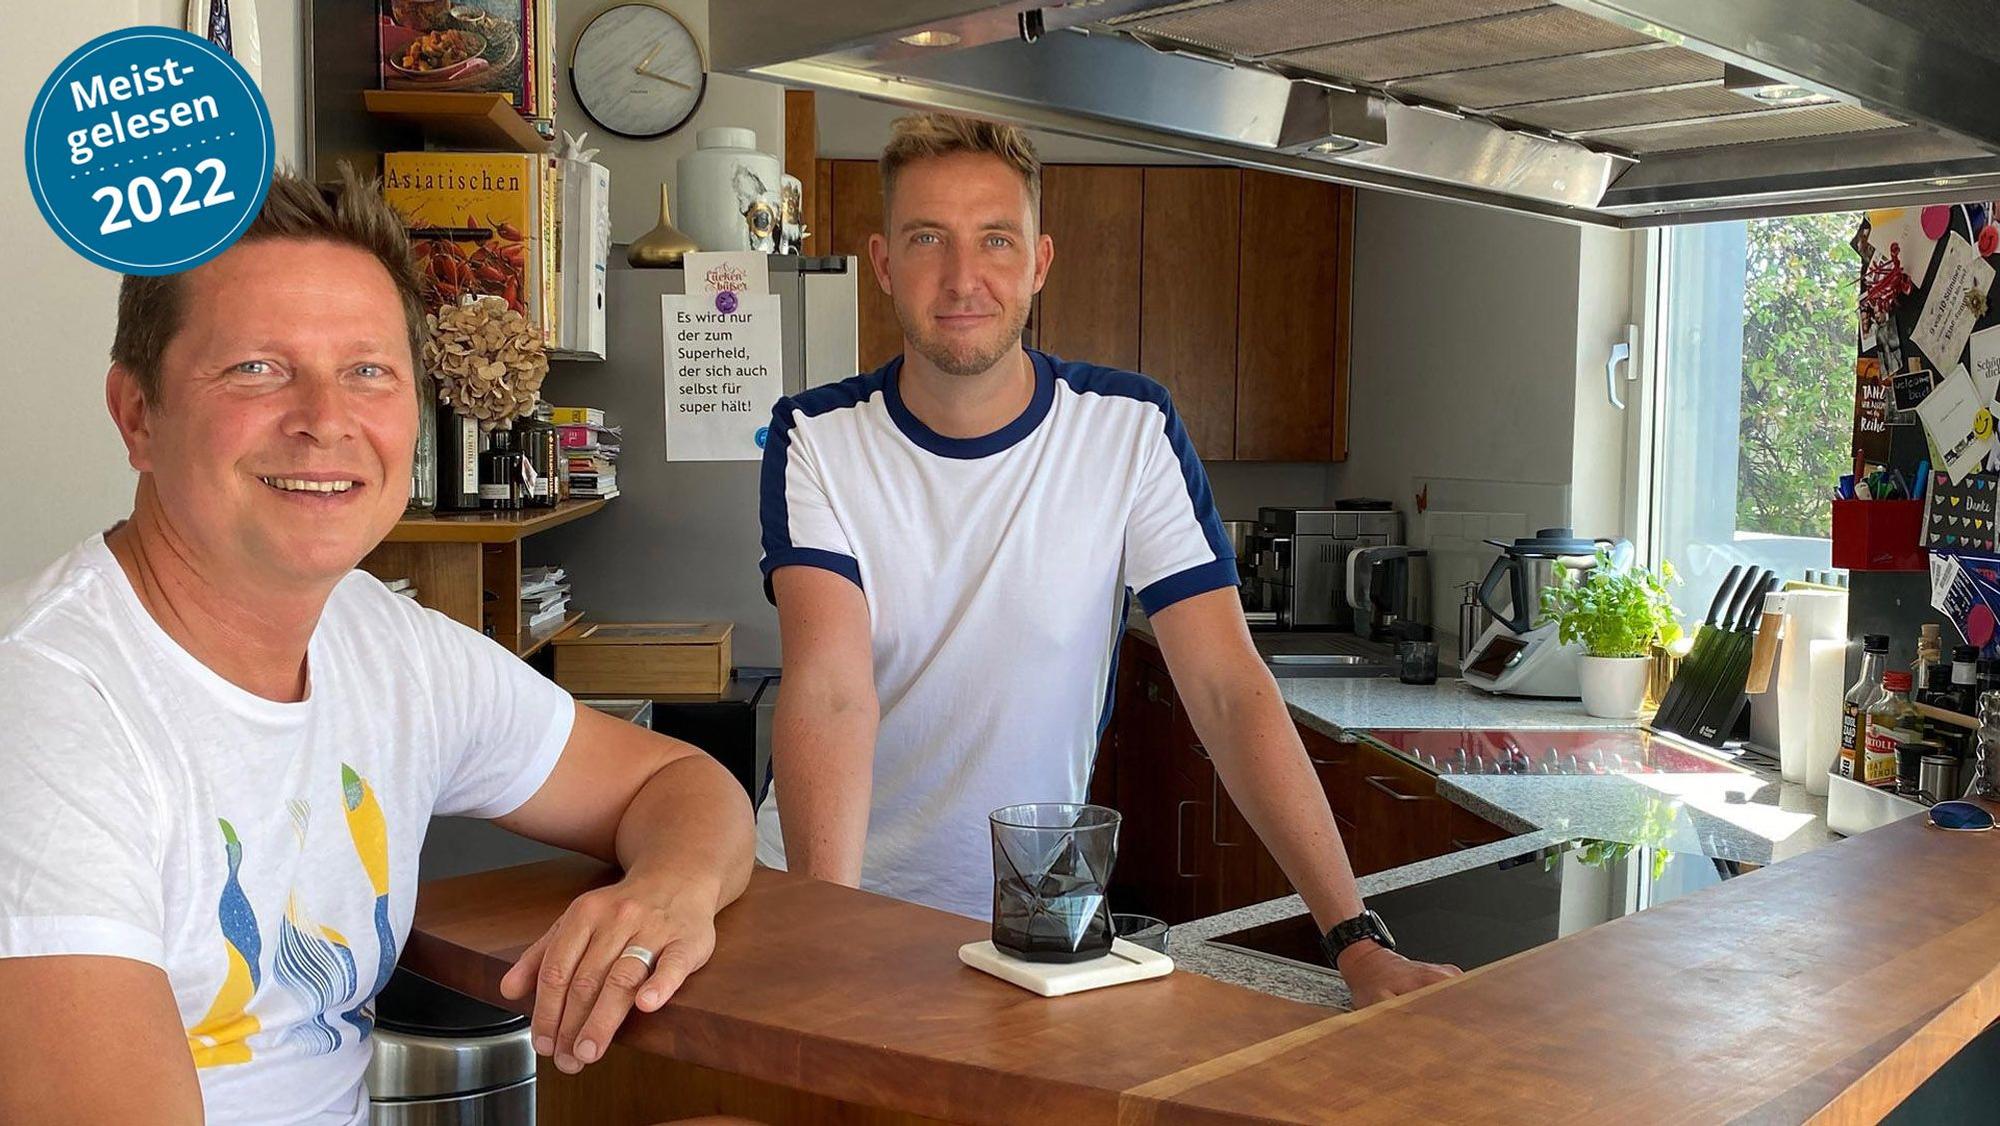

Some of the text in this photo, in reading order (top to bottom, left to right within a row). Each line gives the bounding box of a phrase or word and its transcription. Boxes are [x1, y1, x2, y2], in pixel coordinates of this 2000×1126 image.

[387, 168, 520, 191] Asiatischen
[677, 311, 753, 323] Es wird nur
[677, 329, 733, 341] der zum
[678, 346, 750, 361] Superheld,
[679, 364, 768, 377] der sich auch
[679, 382, 742, 395] selbst für
[1862, 384, 1887, 400] TANZ
[680, 400, 751, 415] super hält!
